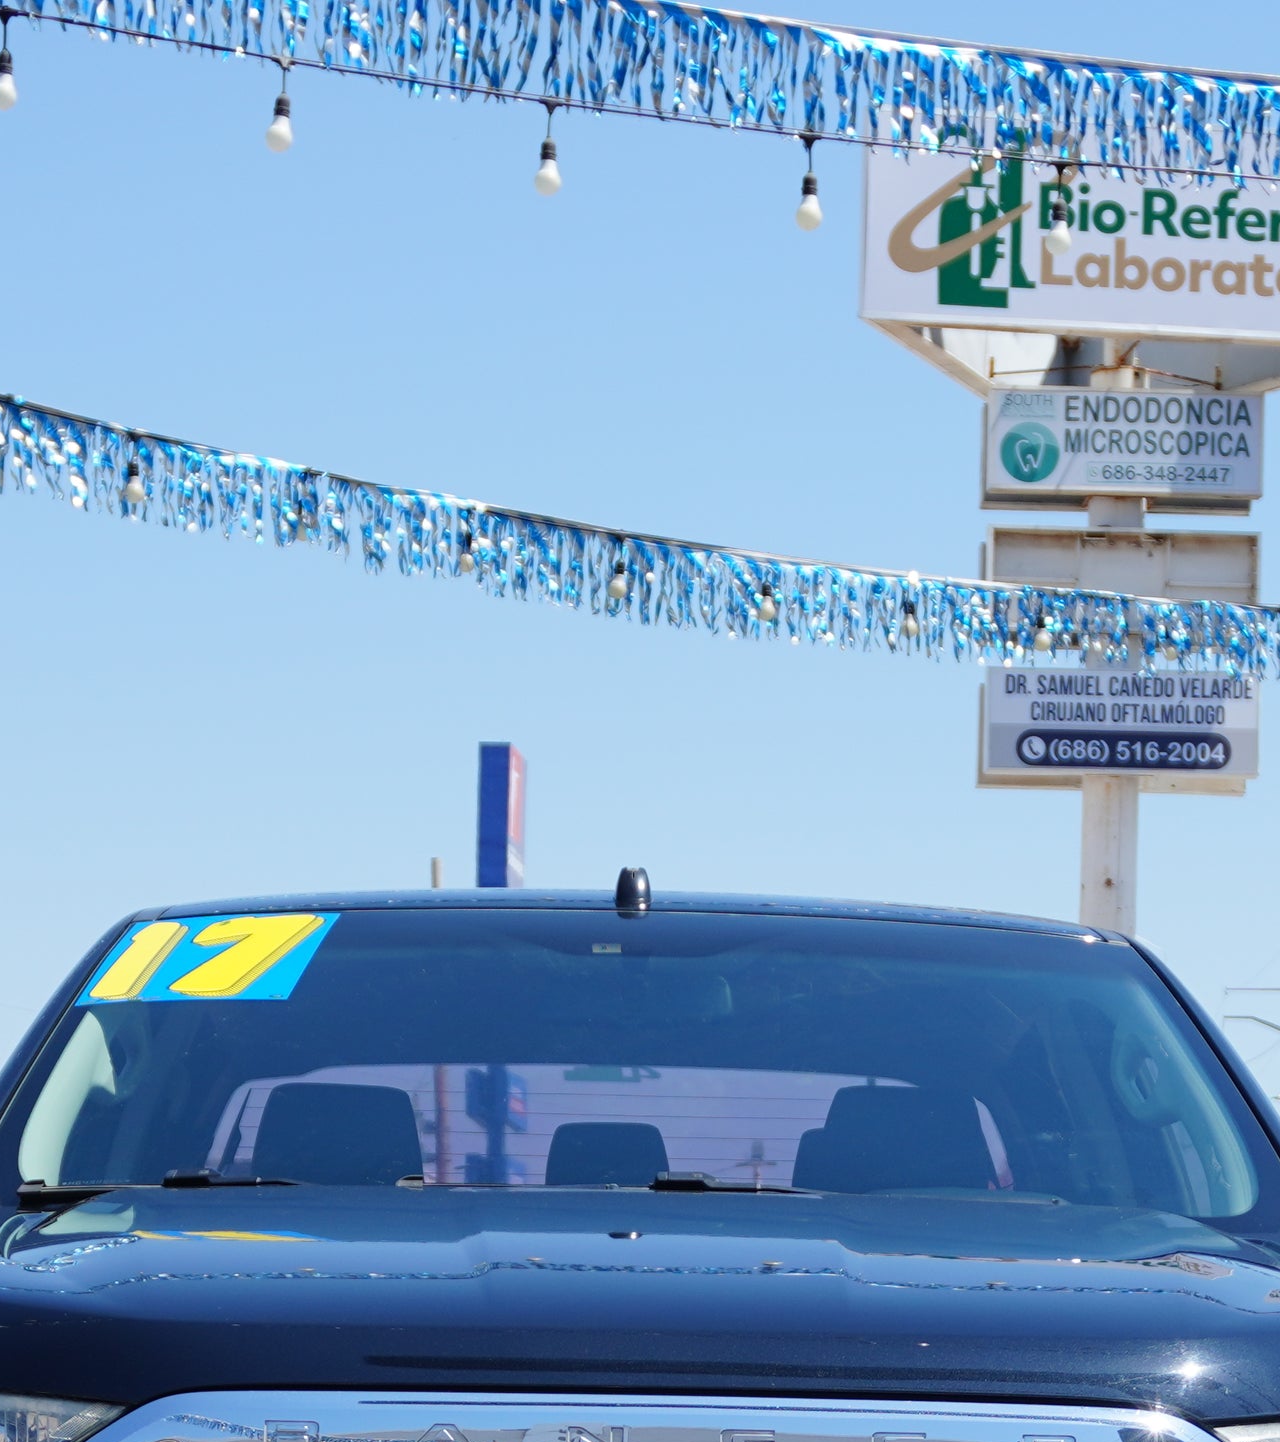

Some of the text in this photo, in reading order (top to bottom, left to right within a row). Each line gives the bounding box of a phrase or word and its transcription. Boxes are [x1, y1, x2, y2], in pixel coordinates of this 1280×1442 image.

[1064, 395, 1252, 427] ENDODONCIA
[1064, 428, 1251, 458] MICROSCOPICA
[1101, 463, 1231, 483] 686-348-2447
[1005, 673, 1032, 695] DR.
[1038, 674, 1104, 697] SAMUEL
[1180, 676, 1254, 700] VELARDE
[1031, 700, 1225, 725] CIRUJANO OFTALMÓLOGO
[1049, 737, 1226, 764] (686) 516-2004
[89, 914, 326, 1001] 17
